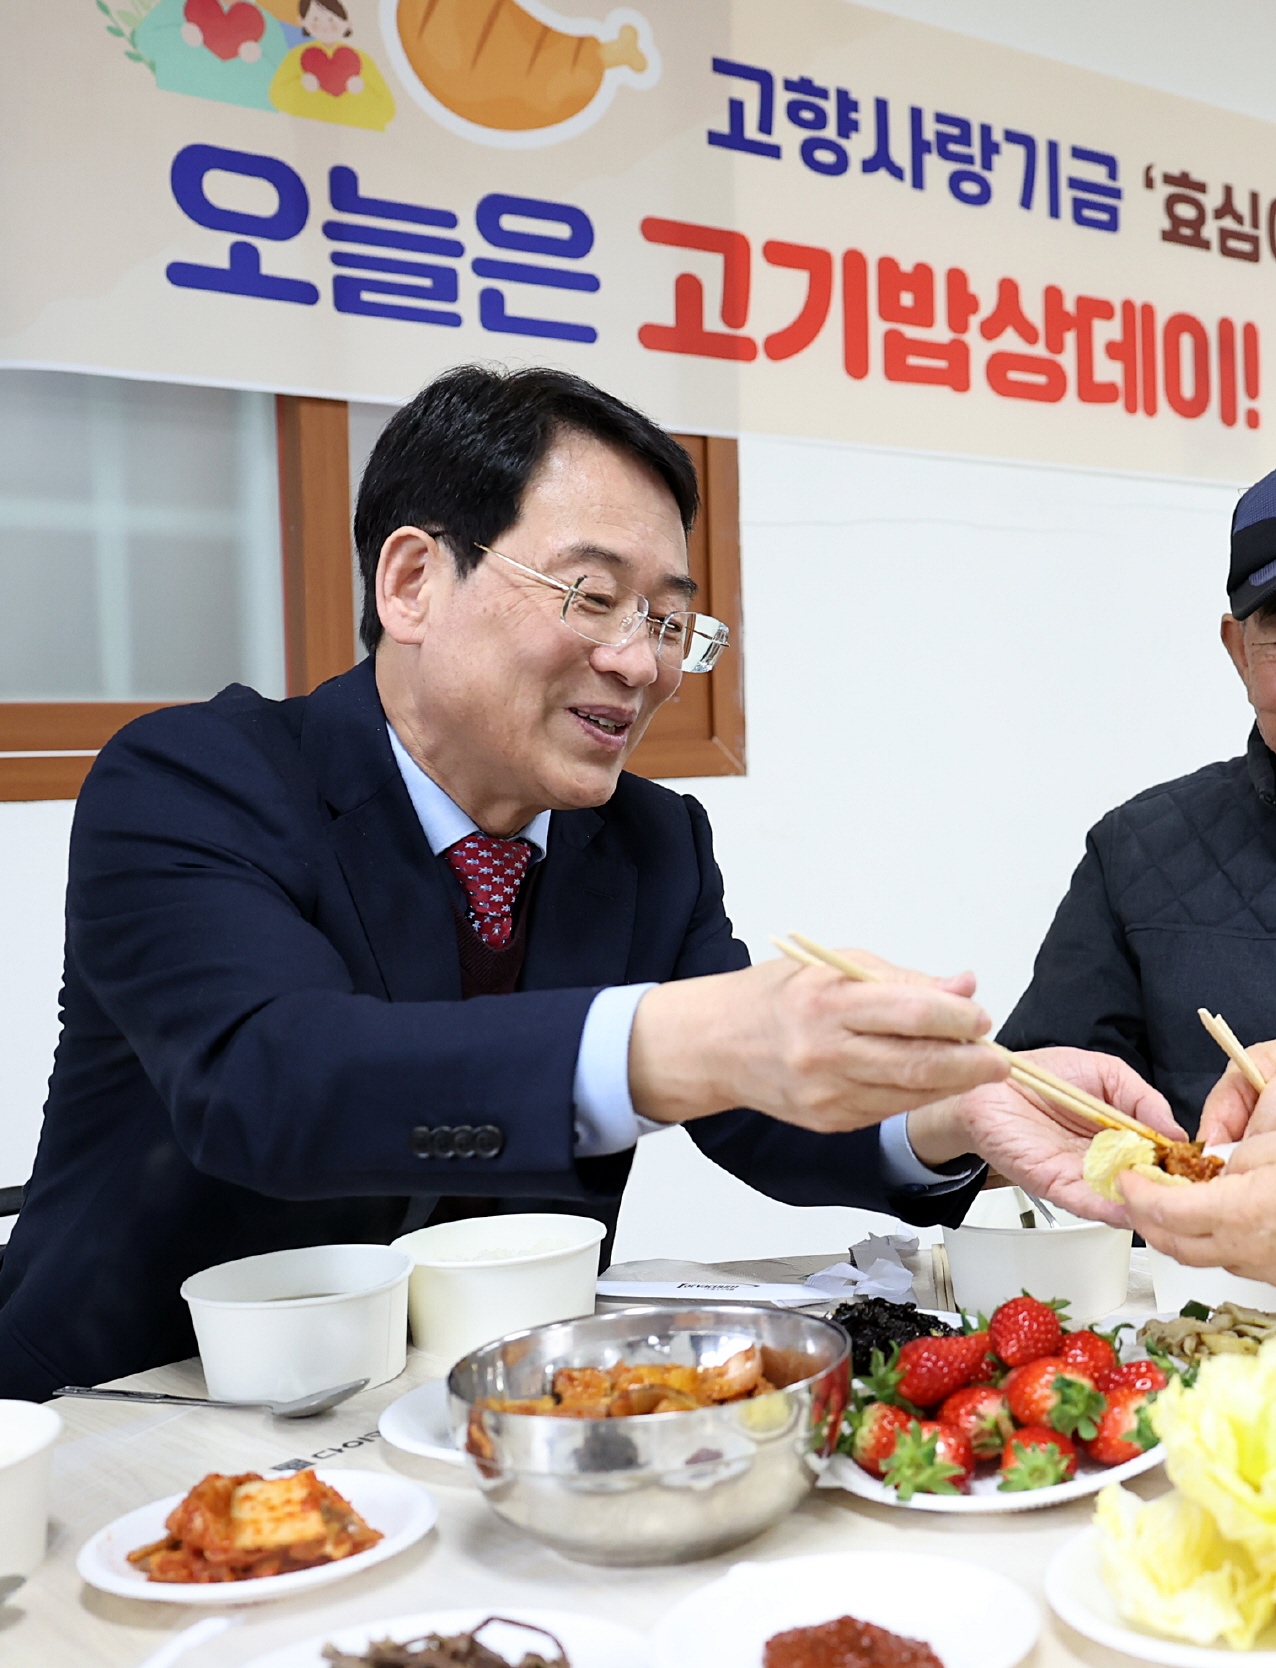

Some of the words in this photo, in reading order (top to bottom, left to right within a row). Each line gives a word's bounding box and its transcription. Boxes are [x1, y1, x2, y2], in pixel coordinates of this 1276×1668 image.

[707, 57, 1123, 233] 고향사랑기금
[166, 144, 601, 344] 오늘은
[638, 216, 1260, 430] 고기밥상데이!
